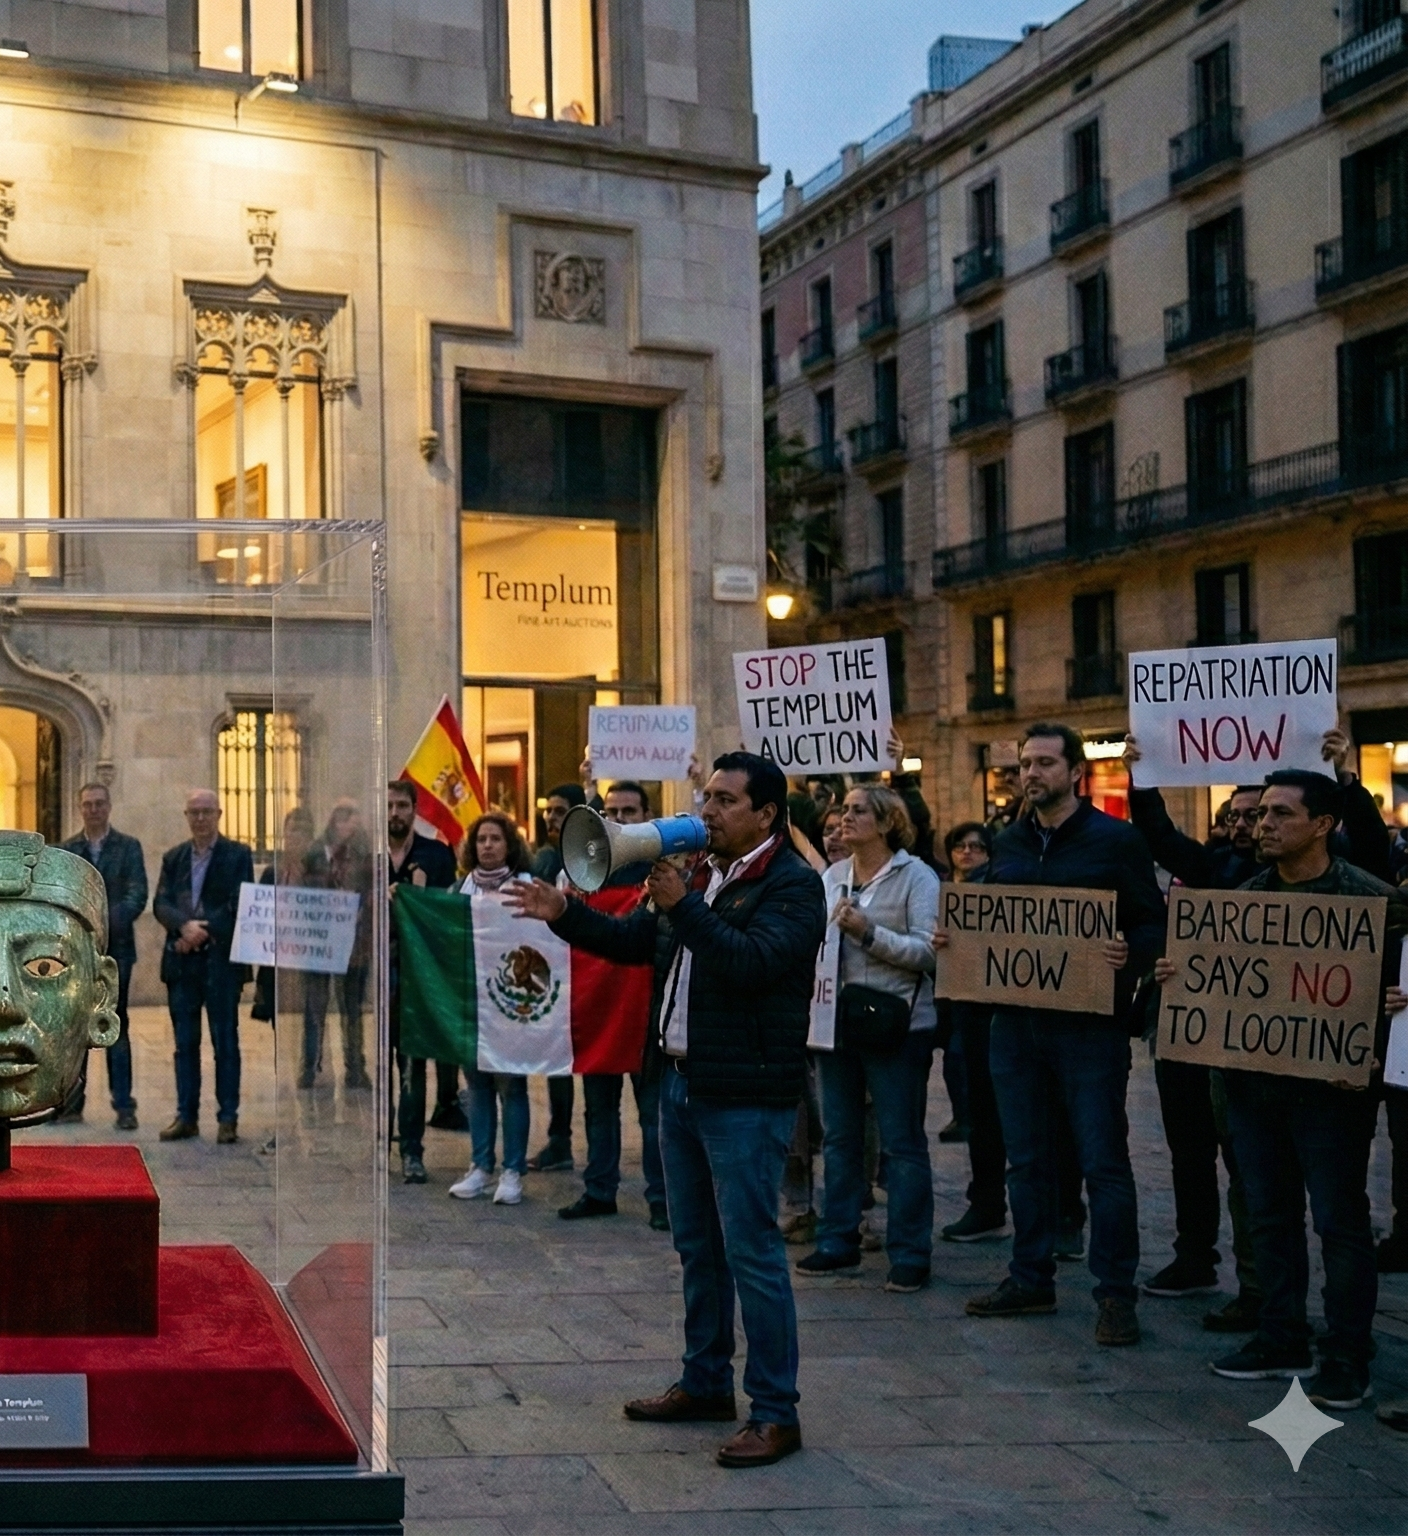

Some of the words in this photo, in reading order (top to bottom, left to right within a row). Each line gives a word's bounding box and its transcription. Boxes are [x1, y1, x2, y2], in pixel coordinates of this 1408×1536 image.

[478, 571, 613, 612] Templum
[745, 653, 816, 689] STOP
[826, 648, 878, 682] THE
[1134, 653, 1333, 703] REPATRIATION
[747, 688, 878, 729] TEMPLUM
[760, 729, 879, 766] AUCTION
[1178, 713, 1286, 764] NOW
[944, 892, 1114, 940] REPATRIATION
[1175, 899, 1376, 953] BARCELONA
[986, 946, 1068, 991] NOW
[1185, 954, 1269, 999] SAYS
[1291, 961, 1352, 1007] NO
[1167, 1004, 1207, 1045] TO
[1223, 1009, 1371, 1067] LOOTING
